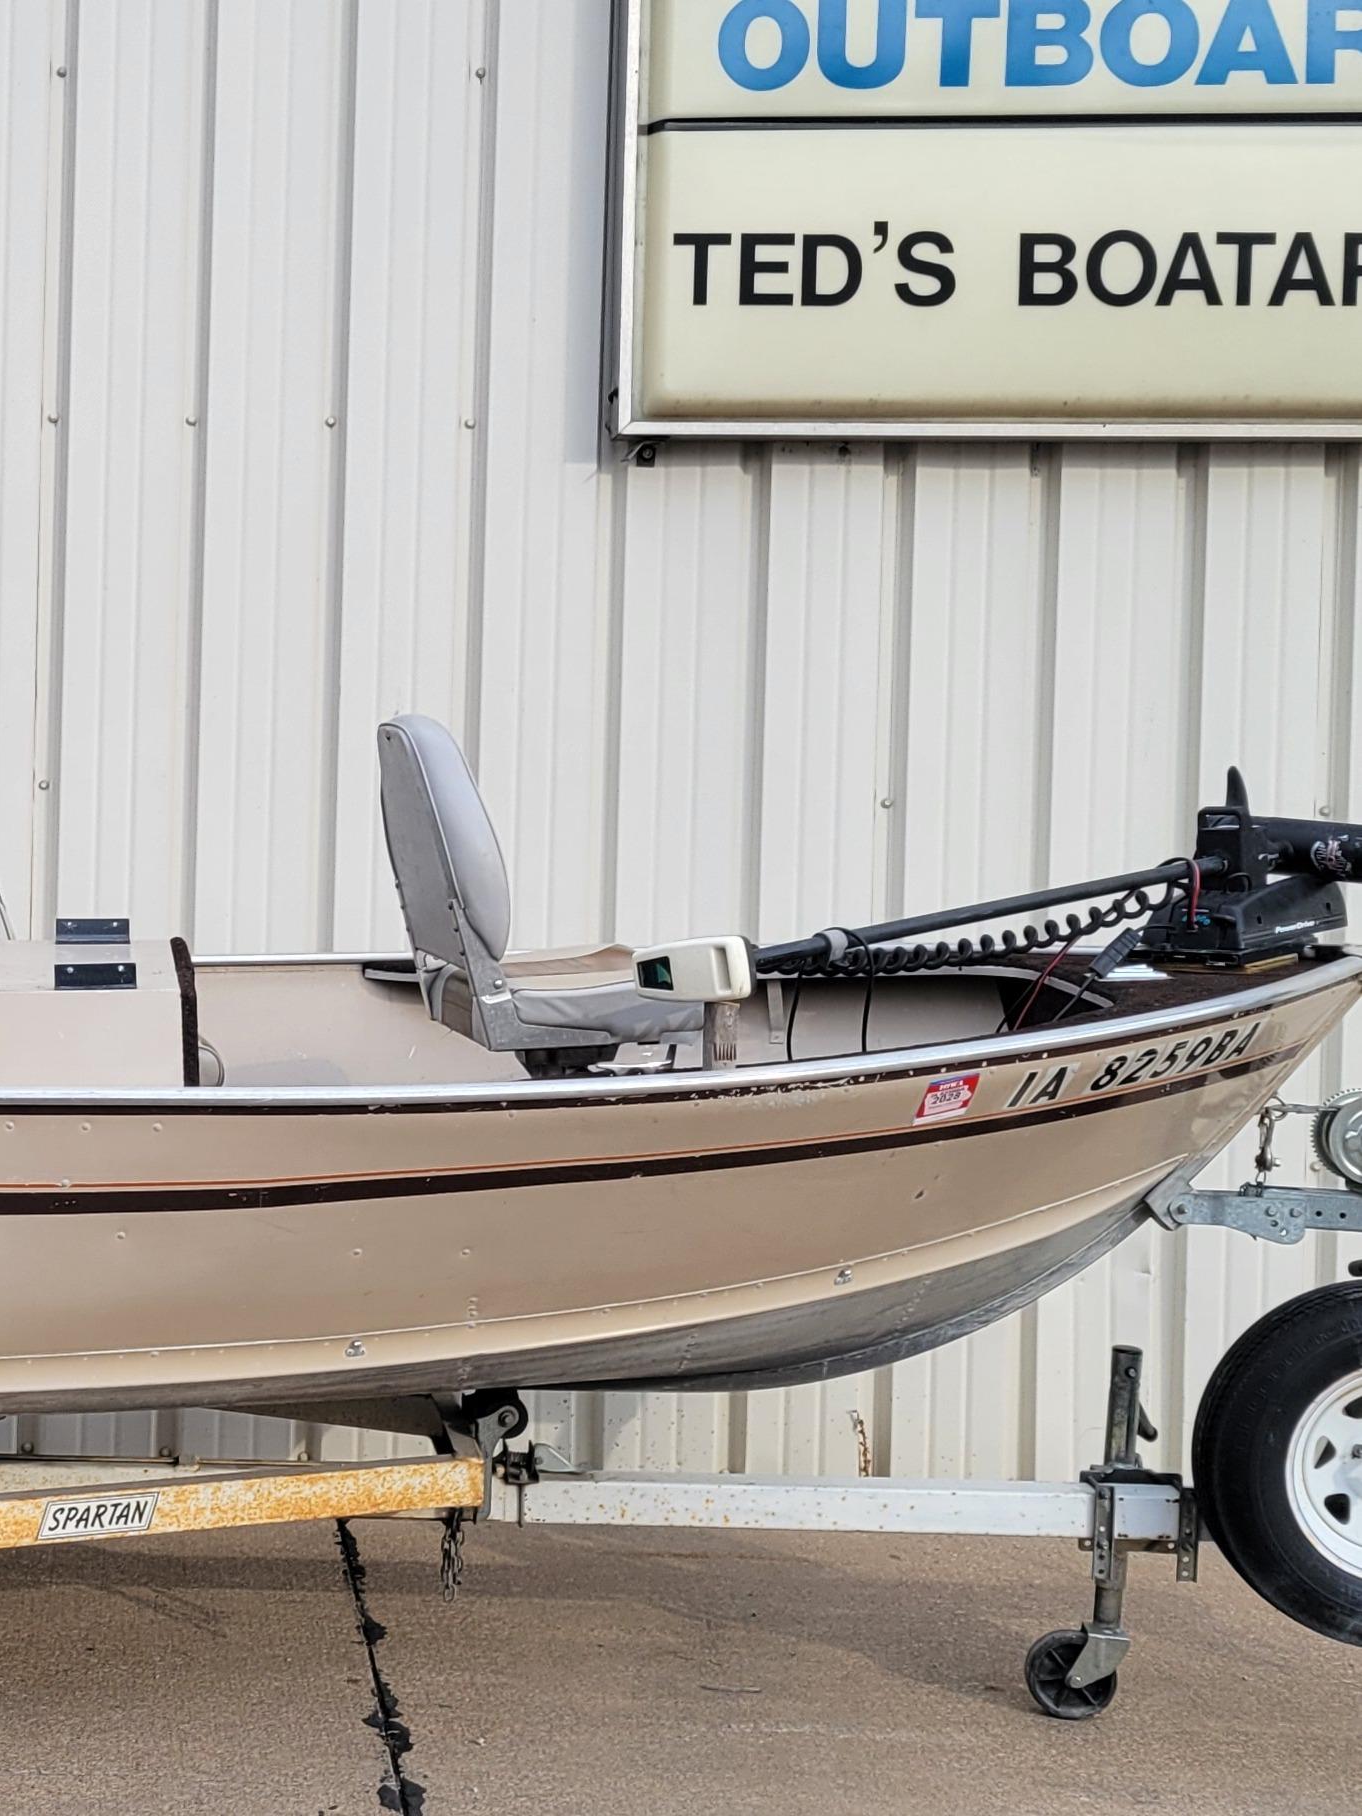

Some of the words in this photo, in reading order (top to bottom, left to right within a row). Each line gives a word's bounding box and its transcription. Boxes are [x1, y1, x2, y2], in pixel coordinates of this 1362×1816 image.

[673, 222, 956, 308] TED'S
[1006, 1066, 1069, 1109] IA
[1089, 1021, 1261, 1093] 8259BA
[48, 1500, 148, 1531] SPARTAN
